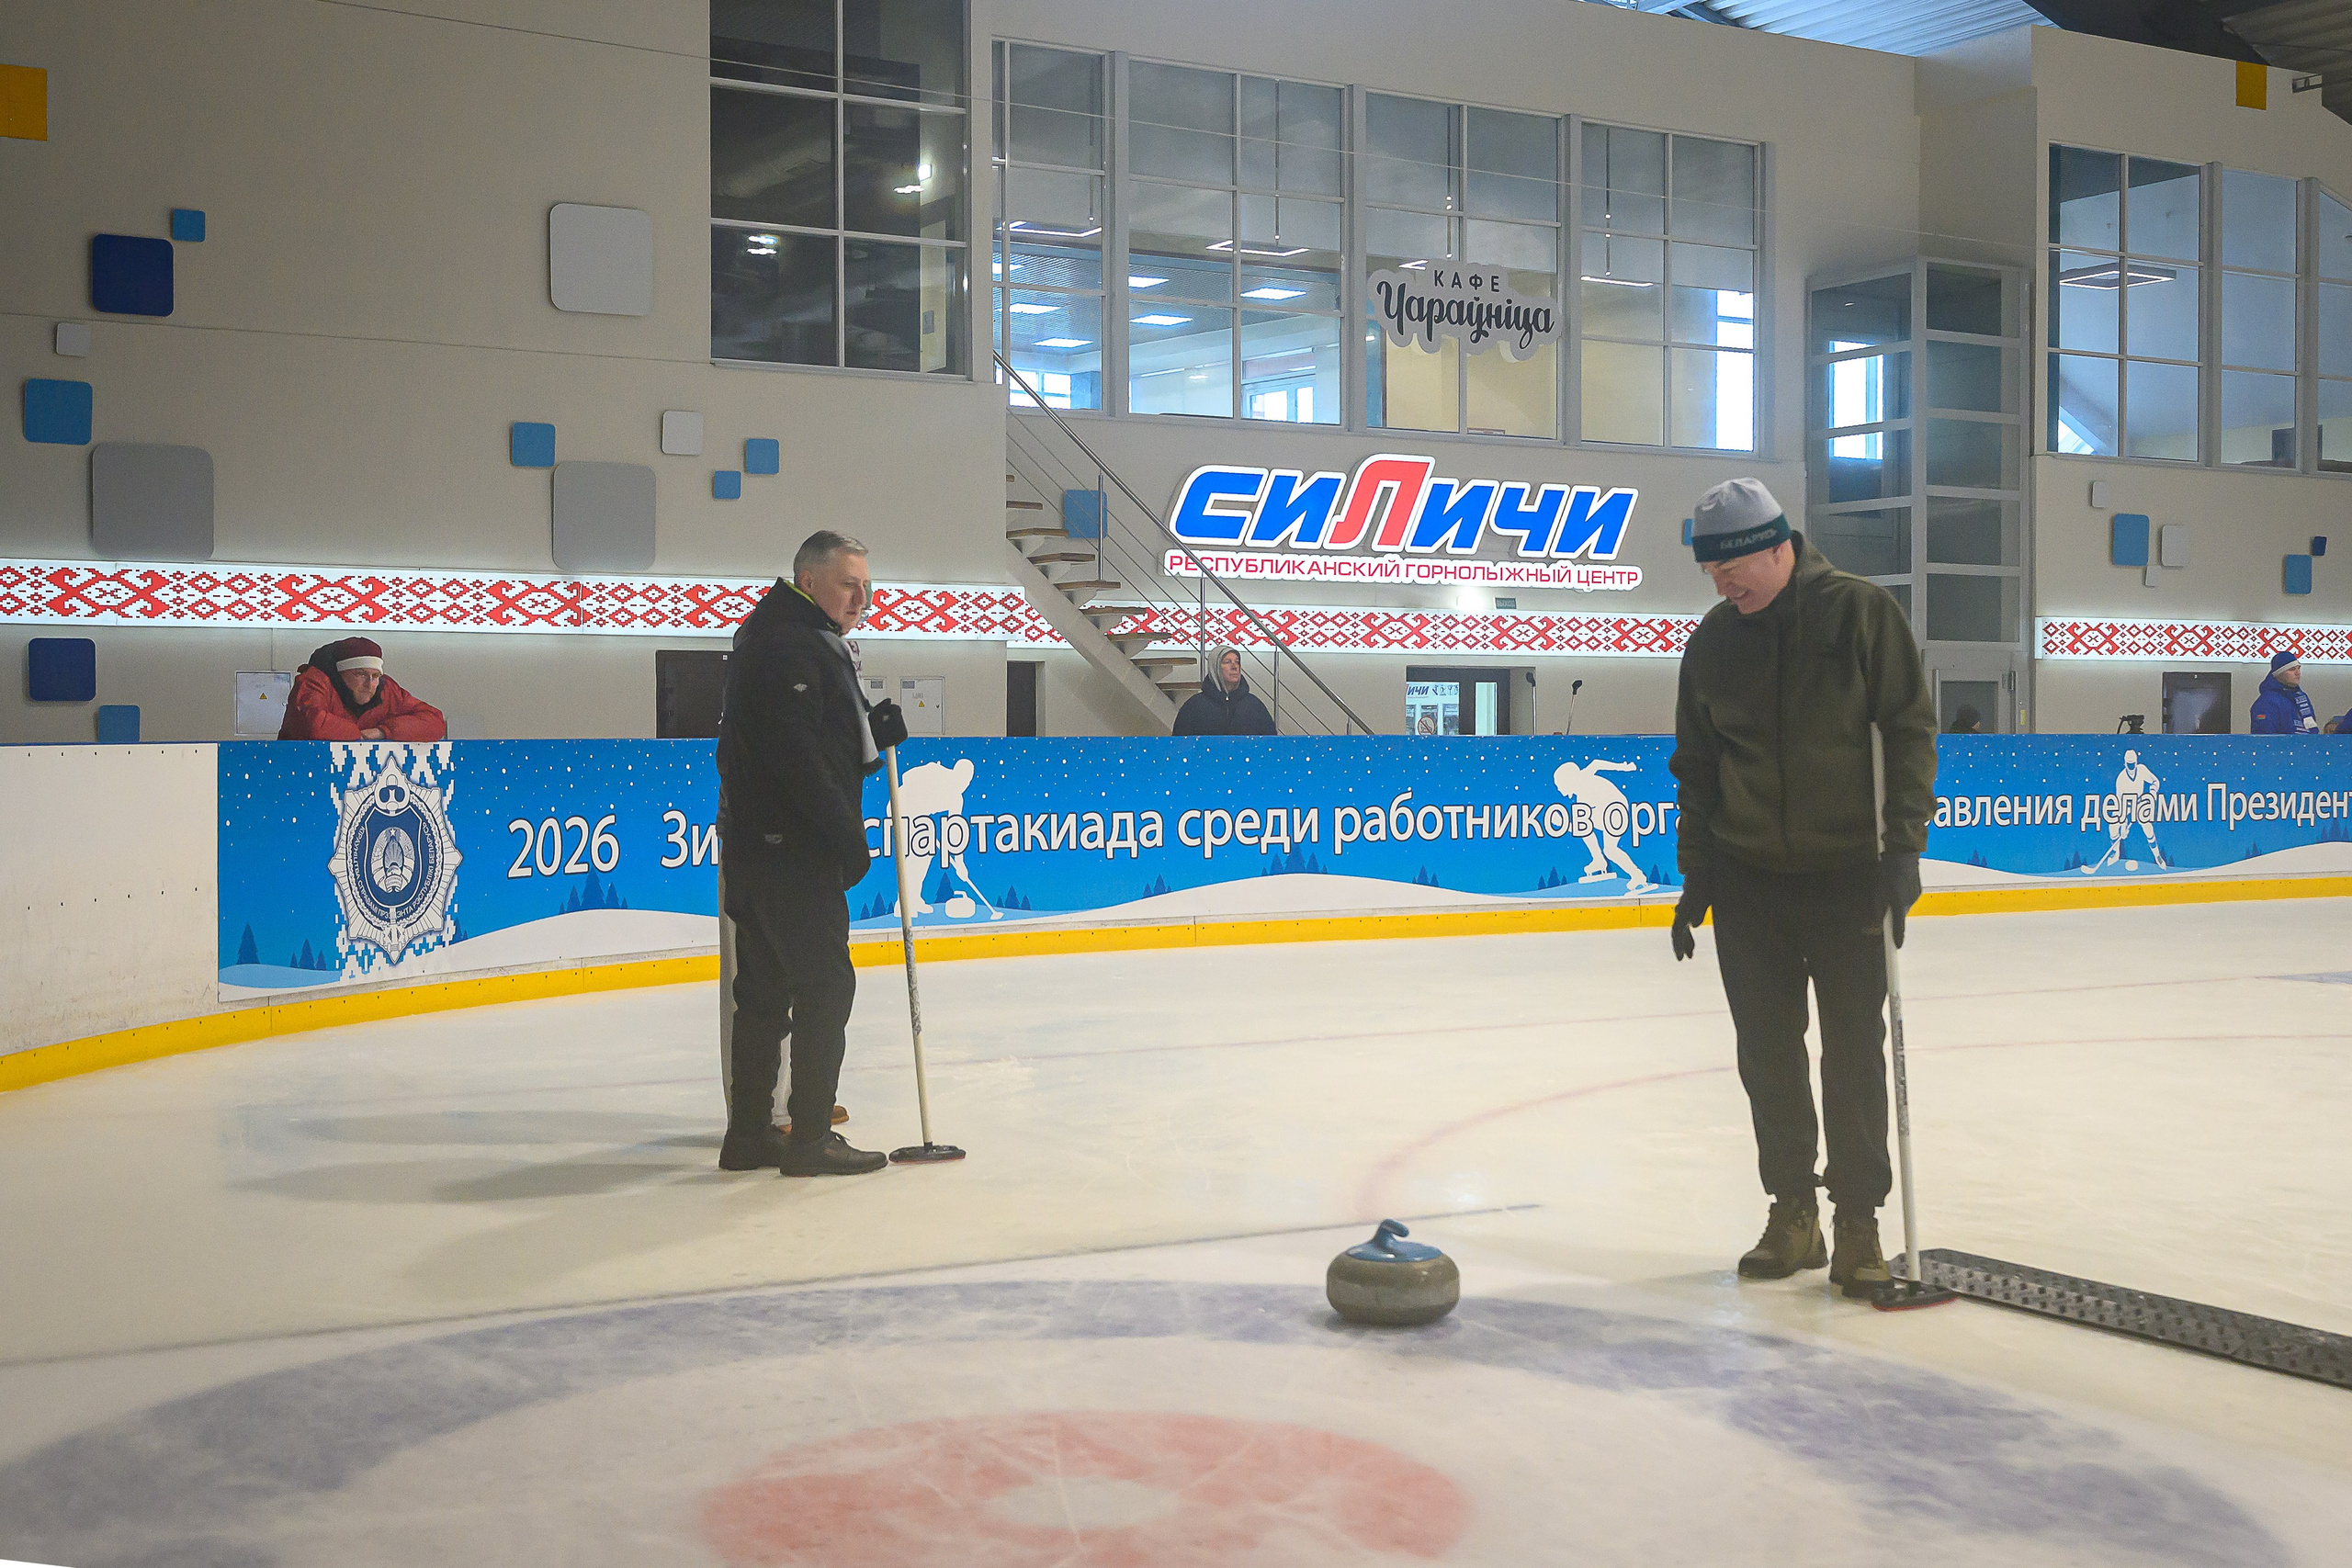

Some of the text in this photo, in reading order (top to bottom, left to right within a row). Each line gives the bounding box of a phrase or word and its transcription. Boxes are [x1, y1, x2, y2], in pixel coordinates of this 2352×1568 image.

[1434, 270, 1500, 292] КАФЕ
[1376, 280, 1555, 350] Чараўніца
[1169, 554, 1639, 587] РЕСПУБЛИКАНСКИЙ ГОРНОЛЫЖНЫЙ ЦЕНТР
[1406, 684, 1430, 696] ИЧИ
[507, 813, 621, 880] 2026
[864, 810, 1164, 869] спартакиада
[1177, 806, 1320, 859] среди
[1332, 790, 1595, 856] работников
[1924, 793, 2073, 829] авления
[2079, 792, 2199, 832] делами
[2206, 783, 2352, 831] Президен
